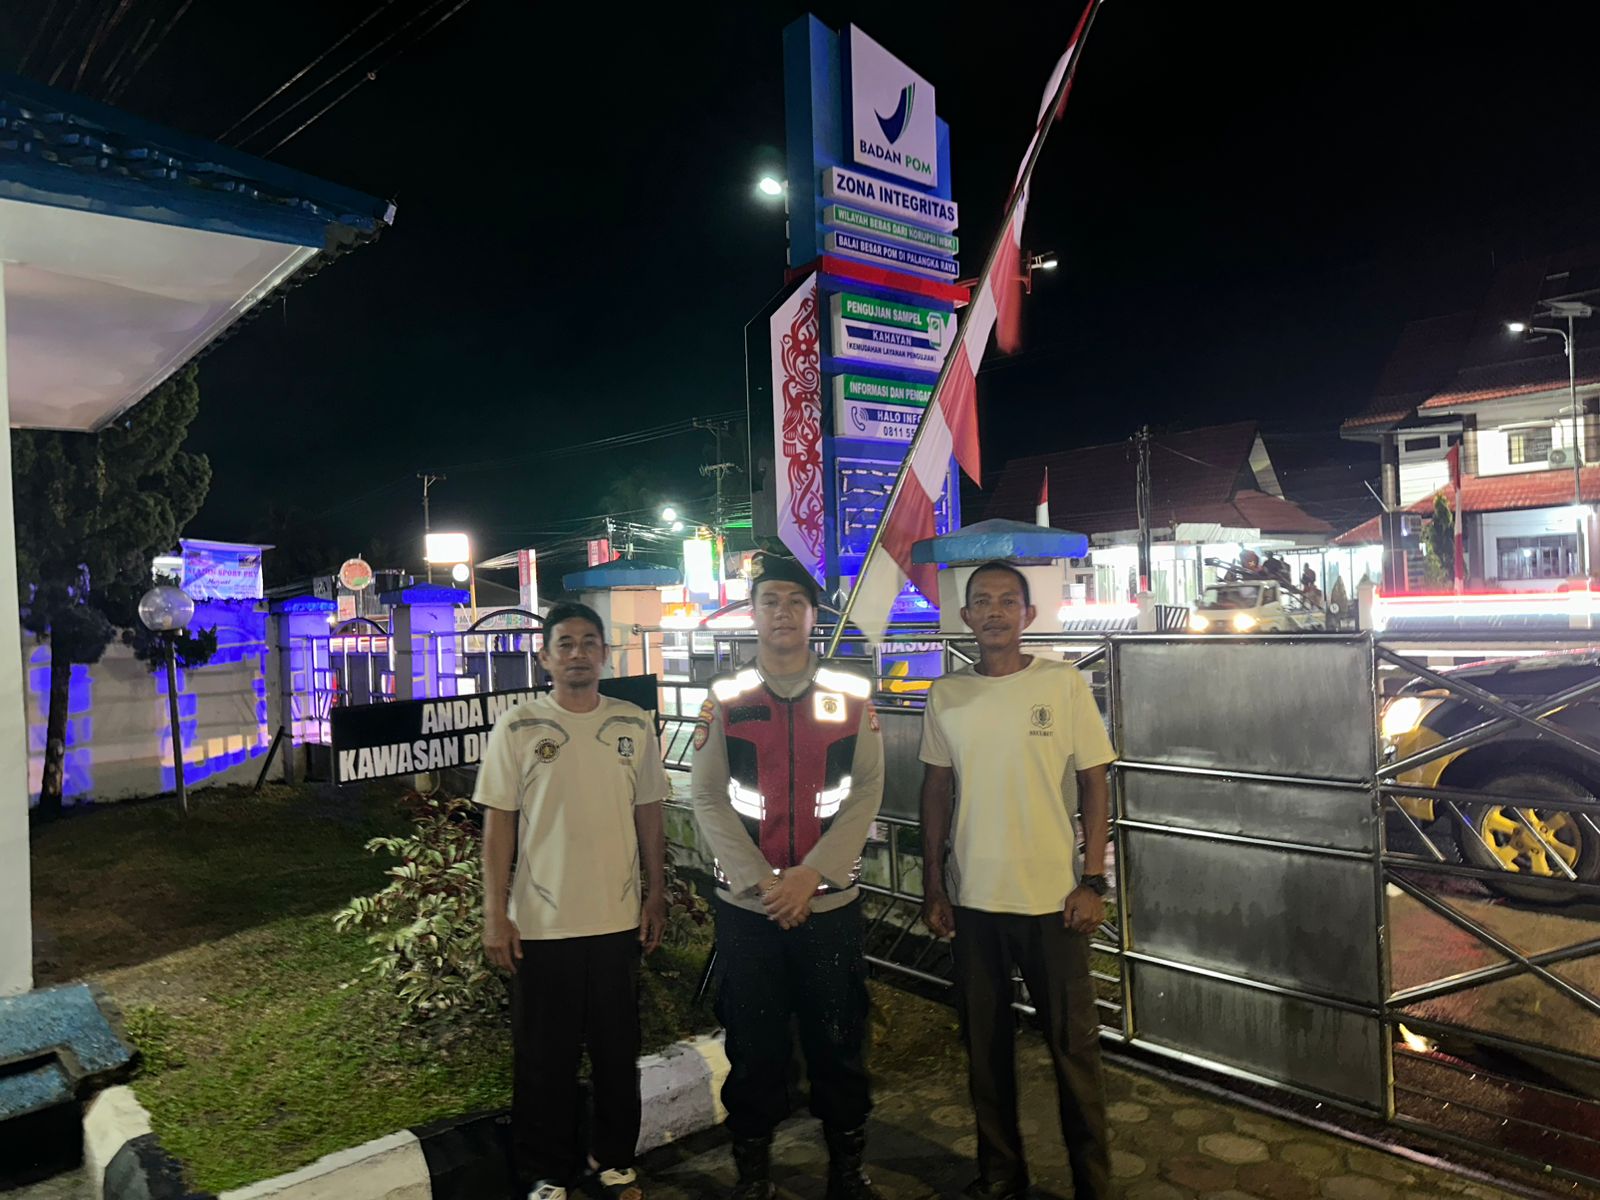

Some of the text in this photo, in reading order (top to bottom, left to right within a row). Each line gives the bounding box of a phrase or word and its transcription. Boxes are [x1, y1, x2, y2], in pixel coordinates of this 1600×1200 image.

[860, 139, 931, 175] BADAN POM
[837, 173, 955, 222] ZONA INTEGRITAS
[838, 210, 869, 226] WILAYAH
[870, 218, 891, 233] BEBAS
[892, 224, 908, 237] DARI
[838, 235, 956, 273] BALAI BESAR POM DI PALANGKA RAYA
[847, 300, 922, 325] PENGUJIAN SAMPEL
[846, 342, 882, 354] (KEMUDAHAN
[883, 347, 906, 358] LAYANAN
[872, 330, 912, 346] KAHAYAN
[849, 382, 889, 398] INFORMASI
[890, 385, 905, 399] DAN
[877, 411, 901, 423] HALO
[883, 426, 903, 438] 0811
[421, 698, 485, 735] ANDA
[339, 735, 459, 783] KAWASAN
